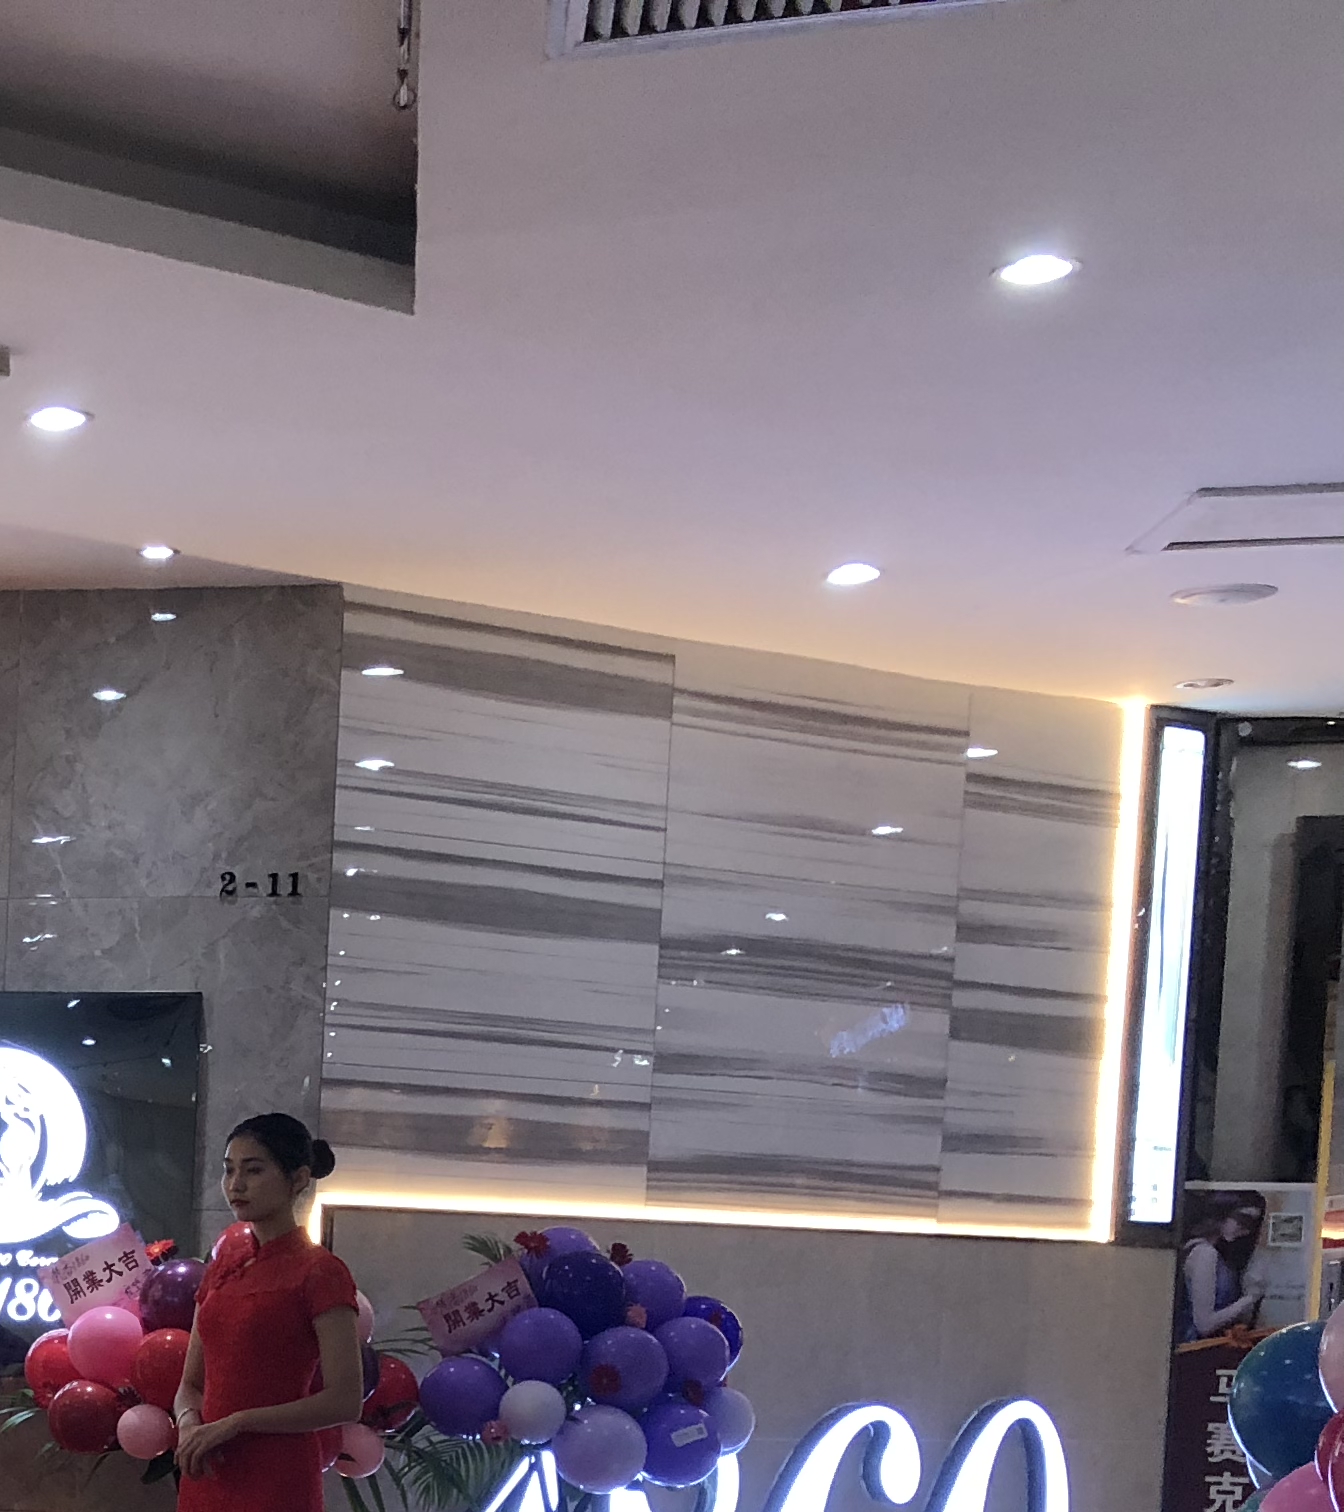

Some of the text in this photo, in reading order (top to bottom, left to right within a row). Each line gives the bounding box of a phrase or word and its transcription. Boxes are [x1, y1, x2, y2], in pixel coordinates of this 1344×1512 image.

[219, 871, 303, 899] 2-11
[63, 1249, 140, 1305] 開業大吉
[443, 1279, 522, 1334] 開業大吉
